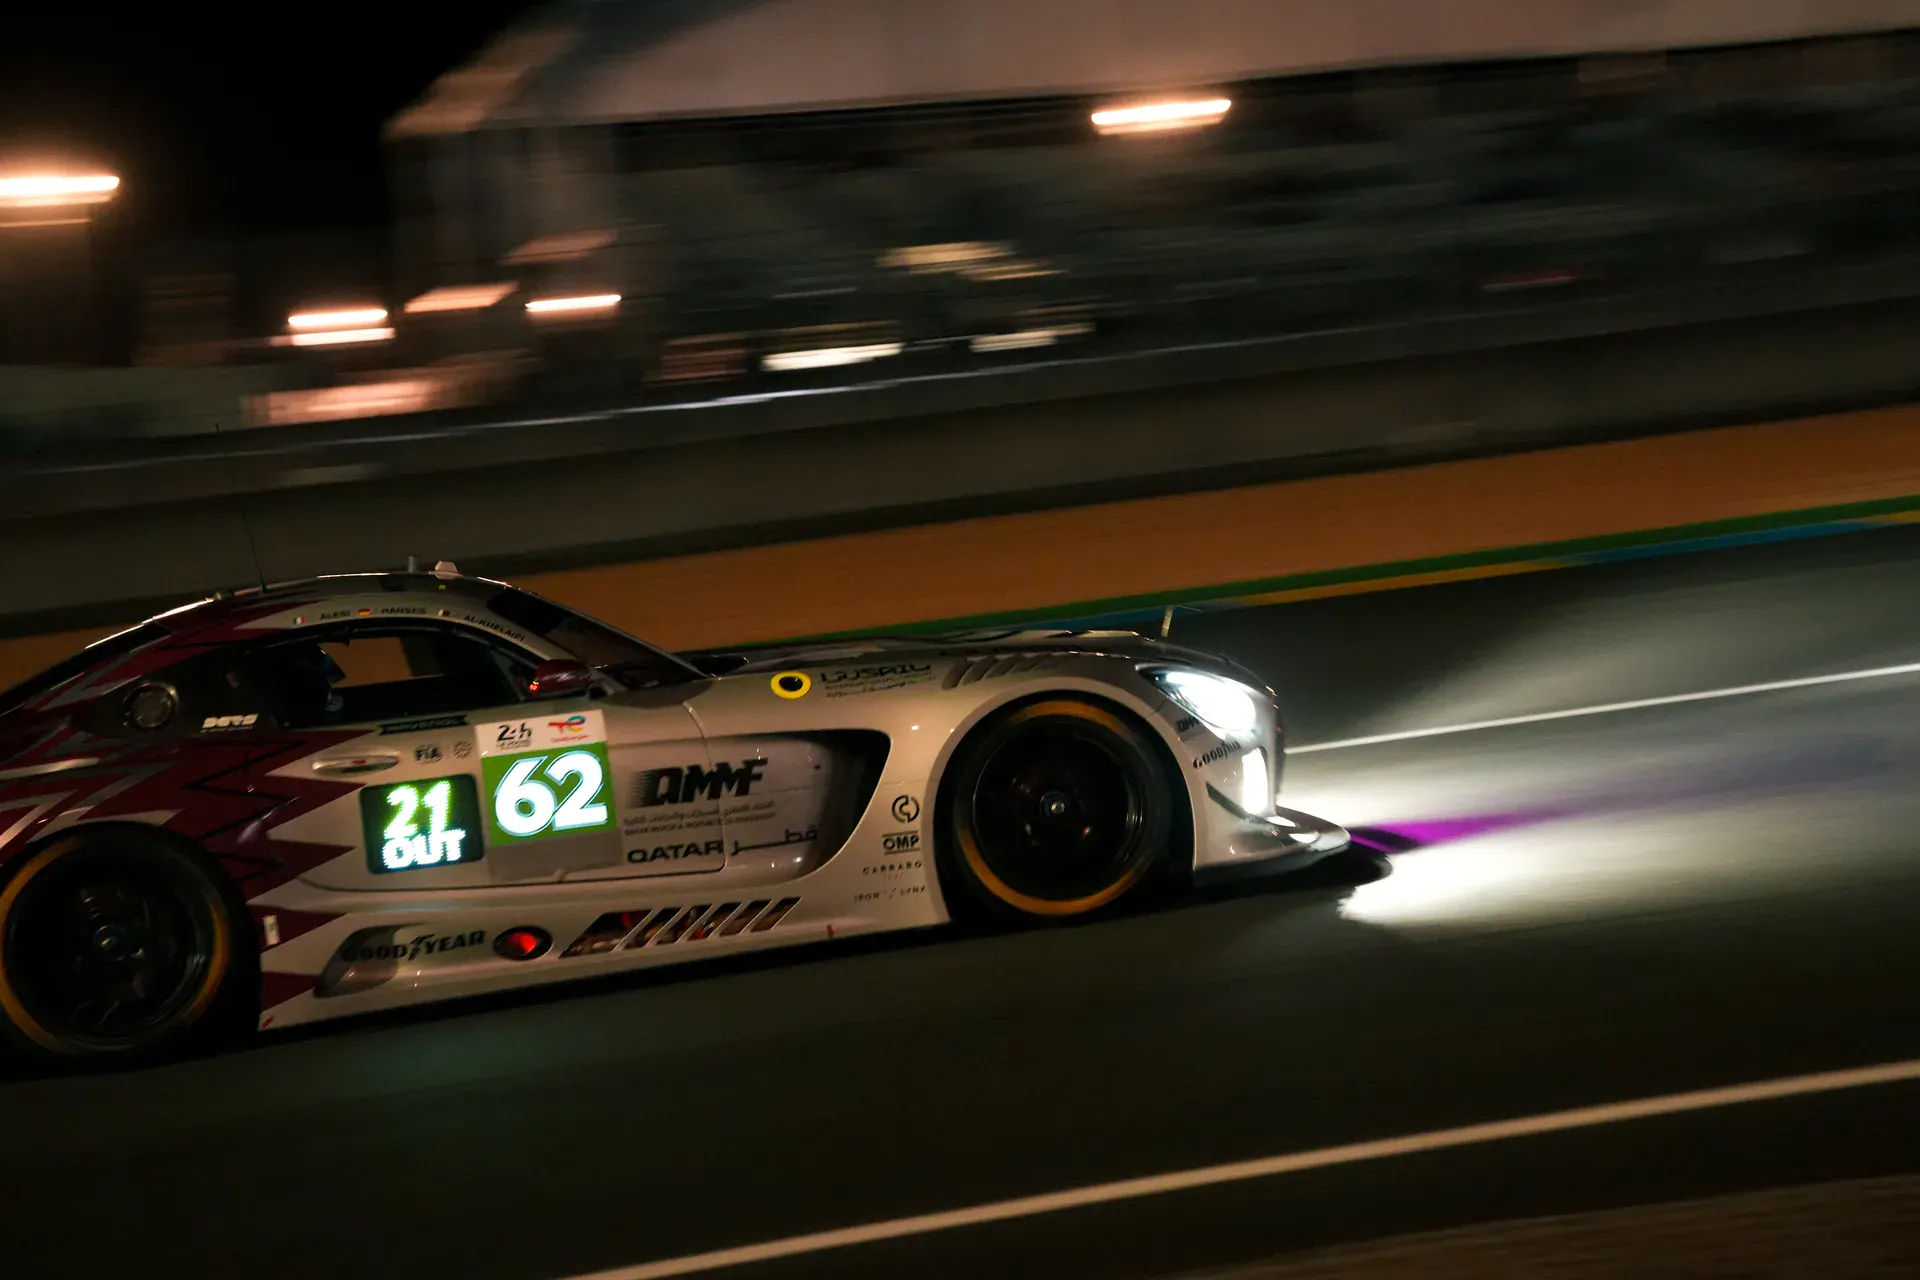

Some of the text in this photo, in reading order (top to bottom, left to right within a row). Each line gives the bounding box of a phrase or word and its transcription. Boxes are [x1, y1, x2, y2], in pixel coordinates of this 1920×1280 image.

[493, 749, 609, 838] 62
[630, 758, 769, 808] QMMF
[384, 780, 453, 838] 21
[381, 828, 466, 870] OUT
[626, 839, 724, 864] QATAR
[883, 835, 919, 850] OMP
[341, 930, 487, 962] GOODYEAR
